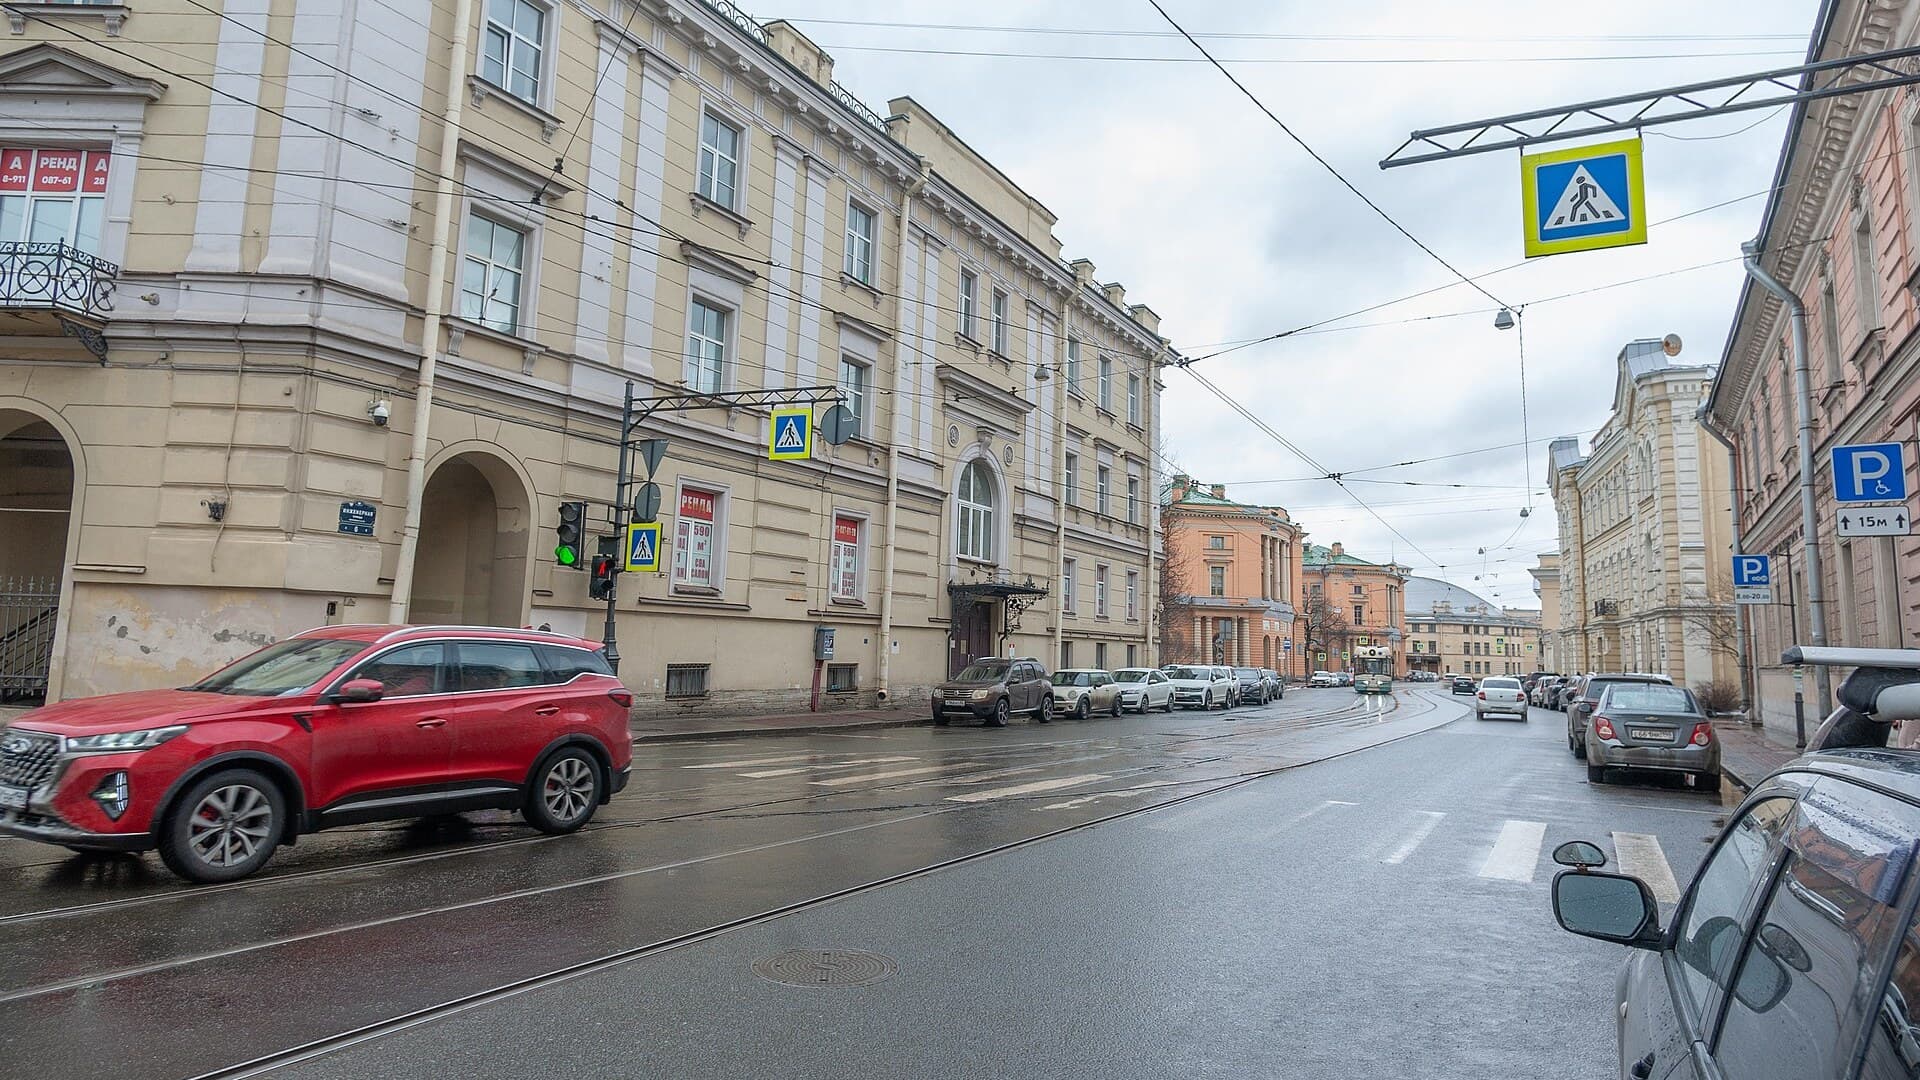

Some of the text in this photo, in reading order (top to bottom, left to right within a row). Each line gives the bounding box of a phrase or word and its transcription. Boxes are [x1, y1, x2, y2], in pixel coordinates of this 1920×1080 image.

[40, 157, 77, 171] РЕНД
[41, 176, 72, 184] 087-61
[1851, 450, 1890, 496] P
[694, 525, 710, 537] 590
[1742, 558, 1763, 583] P
